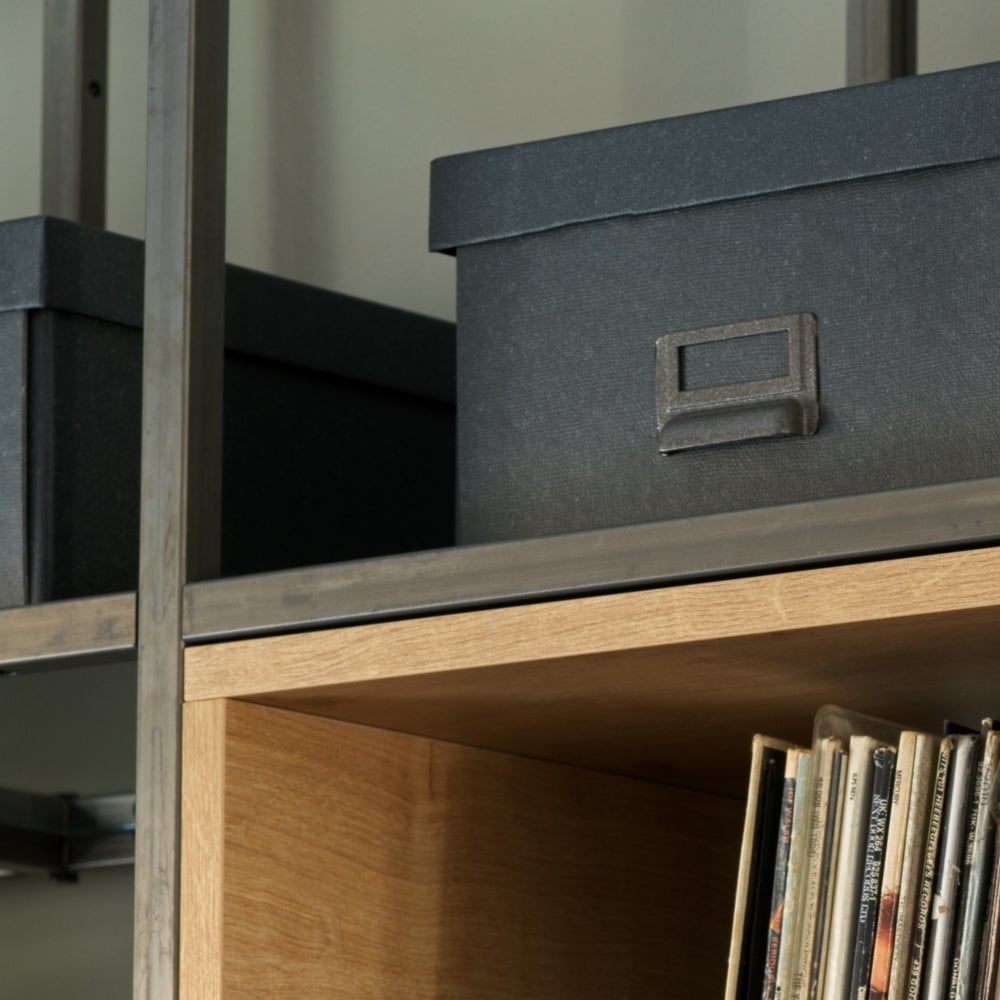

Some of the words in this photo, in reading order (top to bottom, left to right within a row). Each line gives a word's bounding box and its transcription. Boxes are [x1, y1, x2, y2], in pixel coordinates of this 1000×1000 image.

[891, 769, 902, 805] MERCURY
[877, 798, 886, 816] UK:
[875, 817, 884, 833] WX
[873, 834, 883, 851] 264
[917, 879, 932, 929] RECORDS
[792, 972, 803, 990] THE
[947, 956, 961, 999] DONALD
